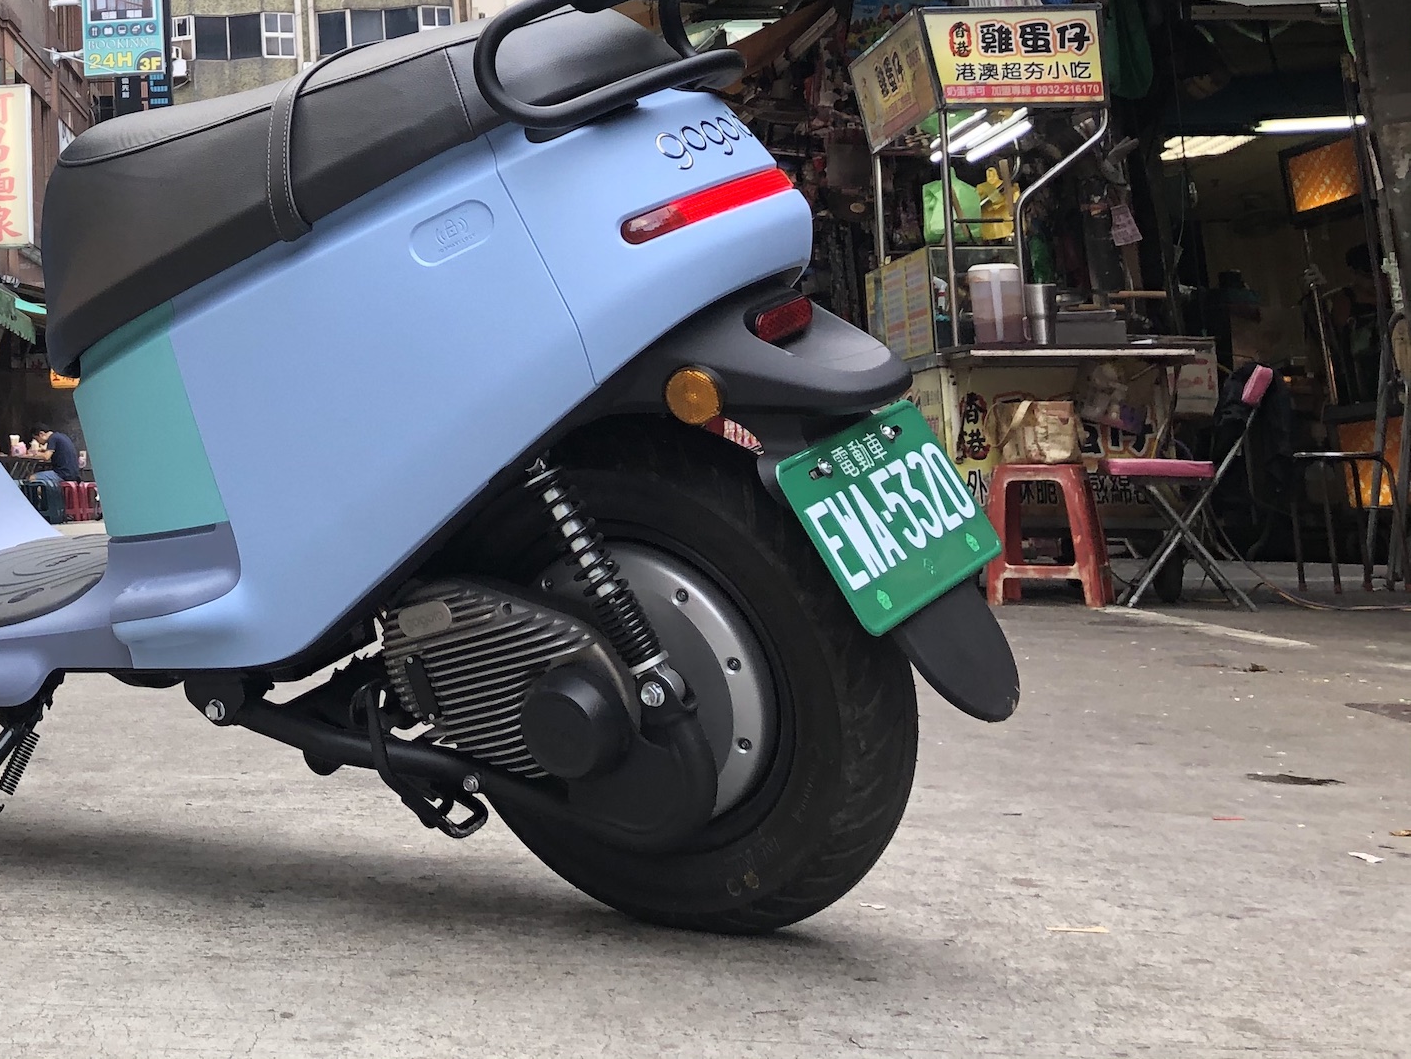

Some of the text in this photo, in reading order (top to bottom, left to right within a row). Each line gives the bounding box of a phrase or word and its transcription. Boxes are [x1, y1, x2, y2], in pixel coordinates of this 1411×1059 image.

[952, 22, 970, 55] 香港
[979, 22, 1090, 54] 雞蛋仔
[89, 51, 161, 70] 24H 3F
[955, 61, 1091, 81] 港澳超夯小吃
[964, 393, 987, 454] 香港
[831, 433, 887, 477] 電動車
[804, 443, 975, 590] EWA-5320
